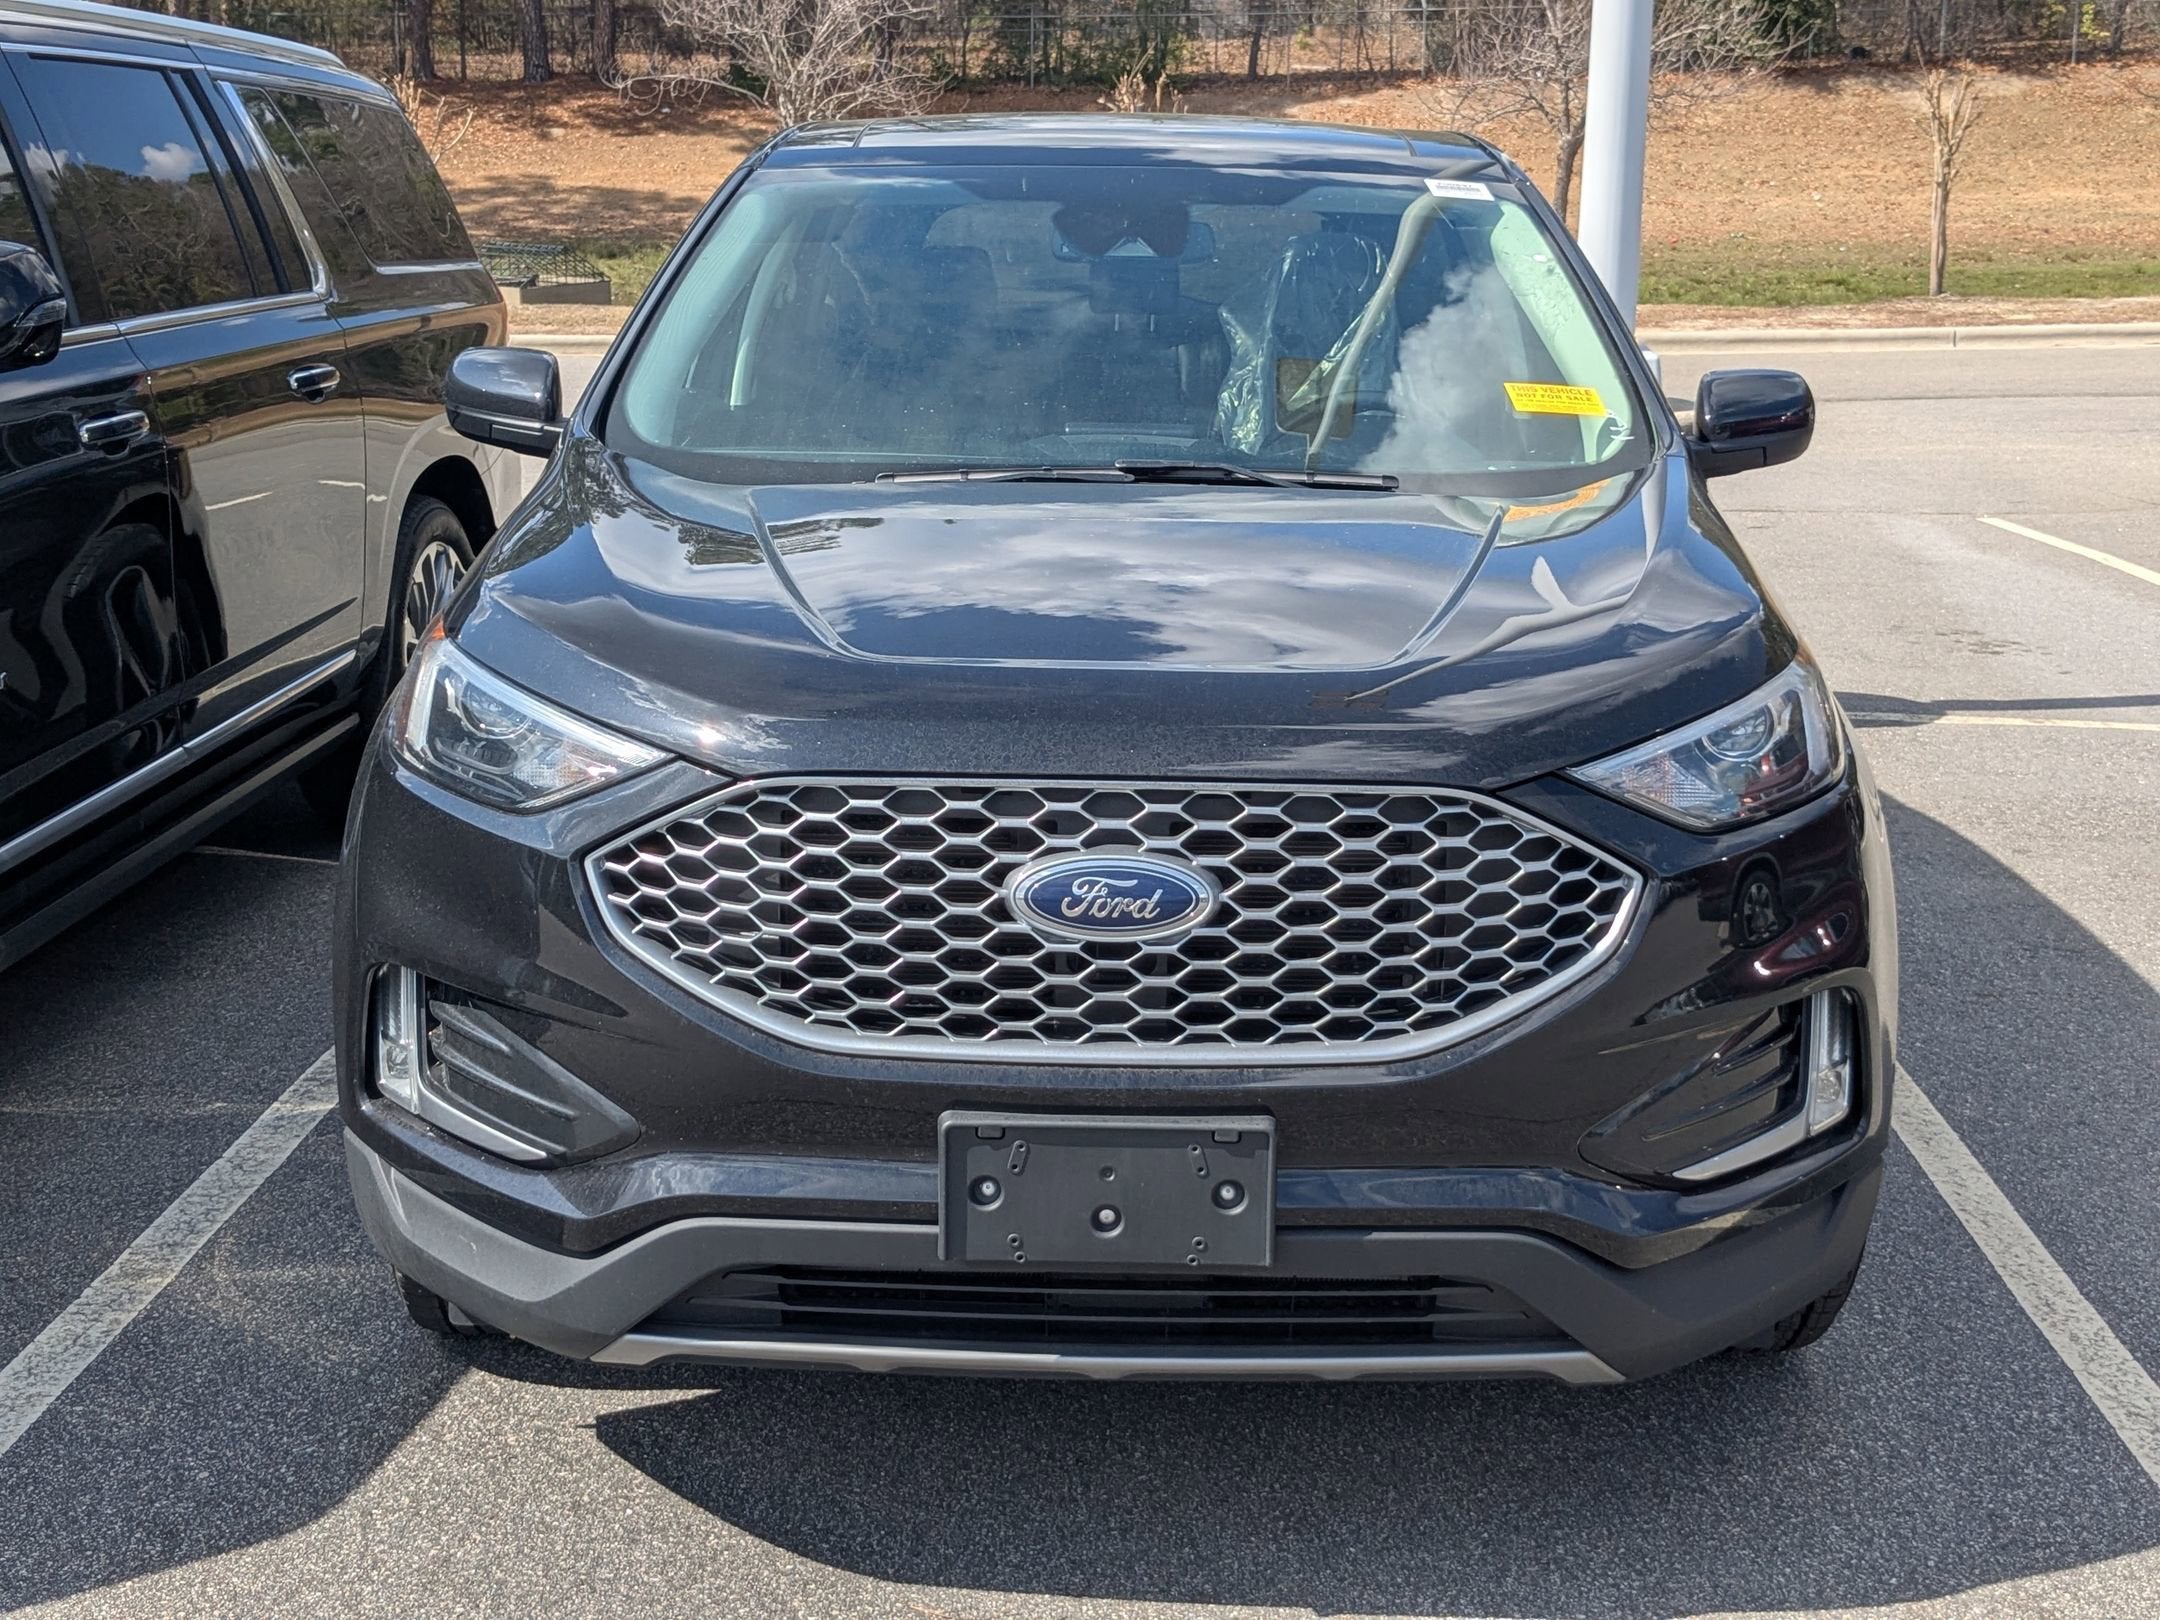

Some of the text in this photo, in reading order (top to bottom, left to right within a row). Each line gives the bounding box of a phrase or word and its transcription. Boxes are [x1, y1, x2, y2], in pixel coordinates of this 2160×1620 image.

[1510, 384, 1593, 397] THIS VEHICLE
[1060, 876, 1164, 918] Ford
